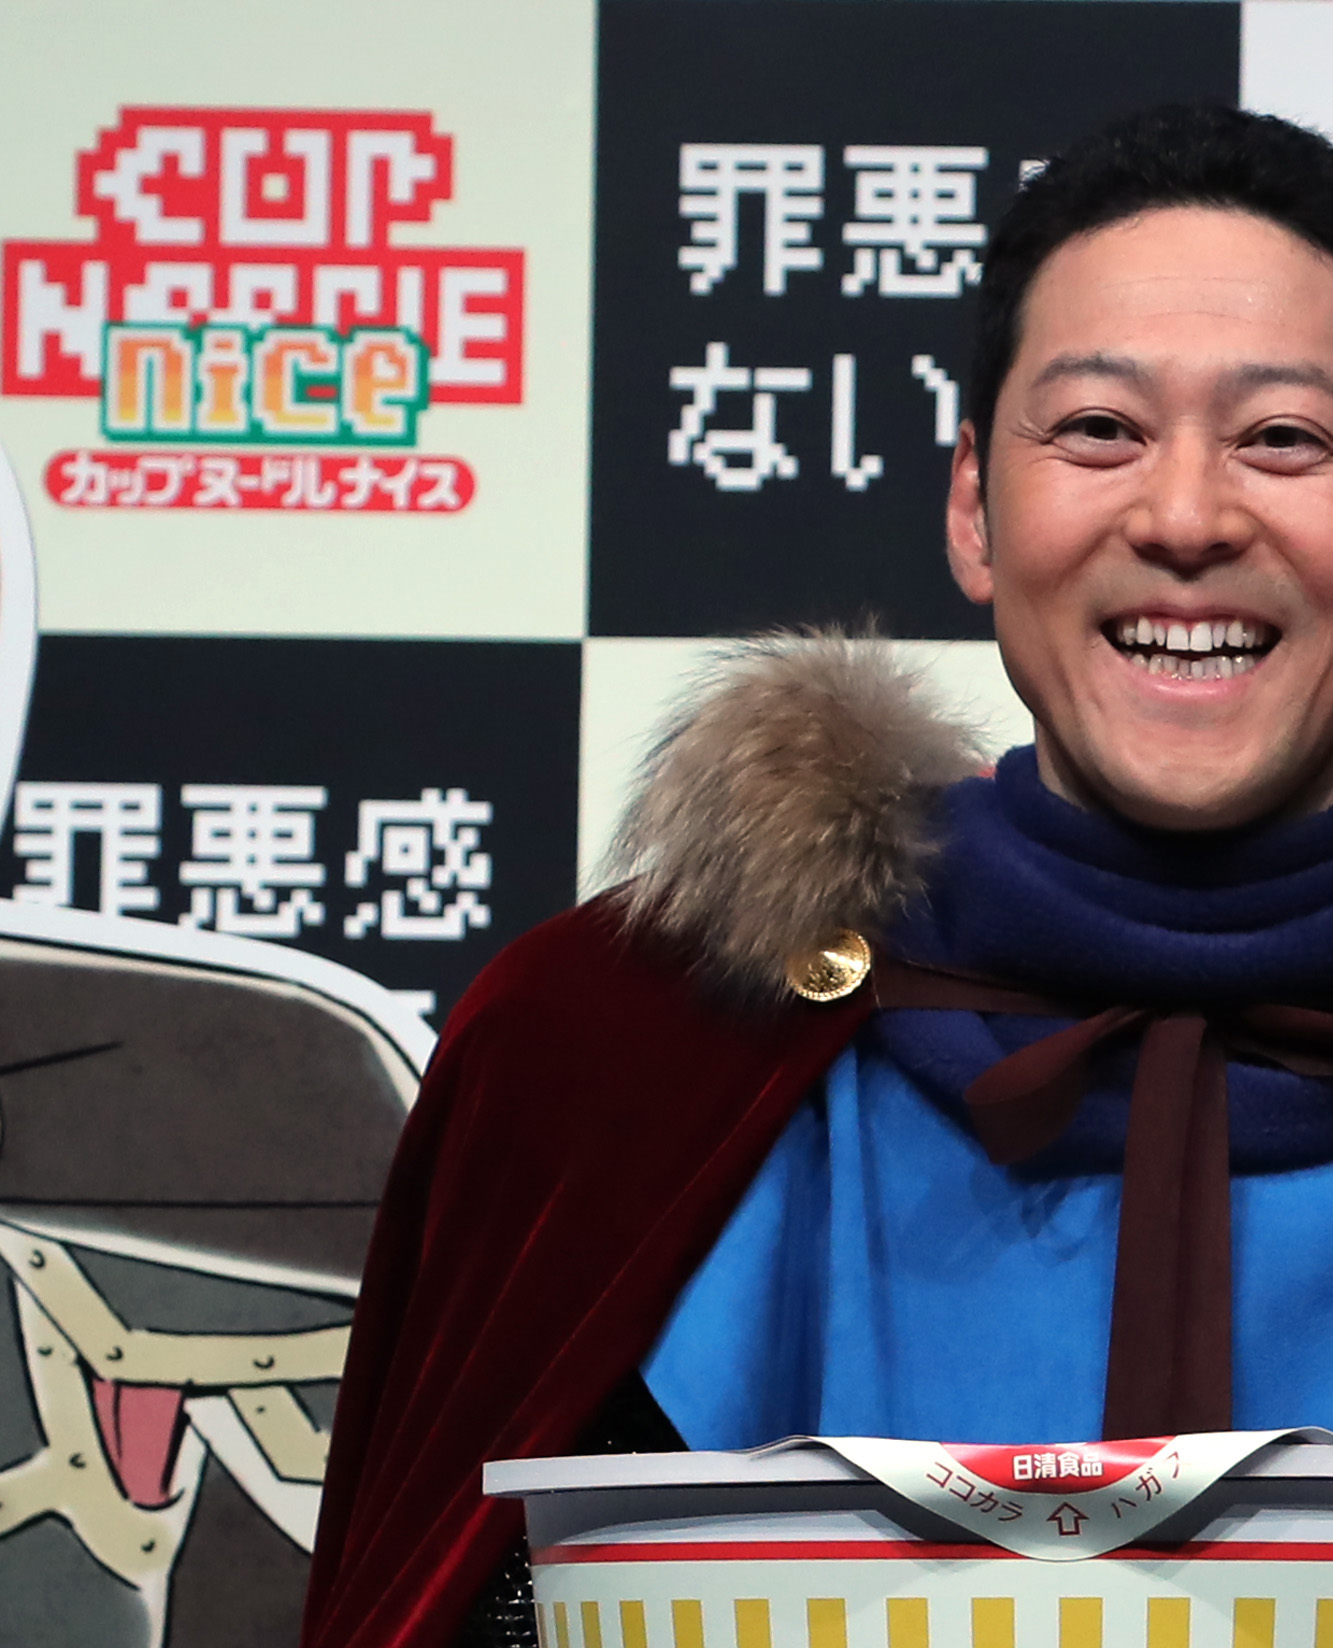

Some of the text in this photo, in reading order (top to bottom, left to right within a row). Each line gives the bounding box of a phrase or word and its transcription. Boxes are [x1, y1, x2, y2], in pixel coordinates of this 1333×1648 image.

[94, 126, 436, 246] CUP
[678, 143, 1050, 296] 罪悪
[109, 328, 424, 436] nice
[60, 453, 460, 509] カップヌードルナイス
[14, 780, 492, 940] 罪悪感
[926, 1461, 1024, 1522] ココカラ
[1012, 1451, 1103, 1481] 日清食品
